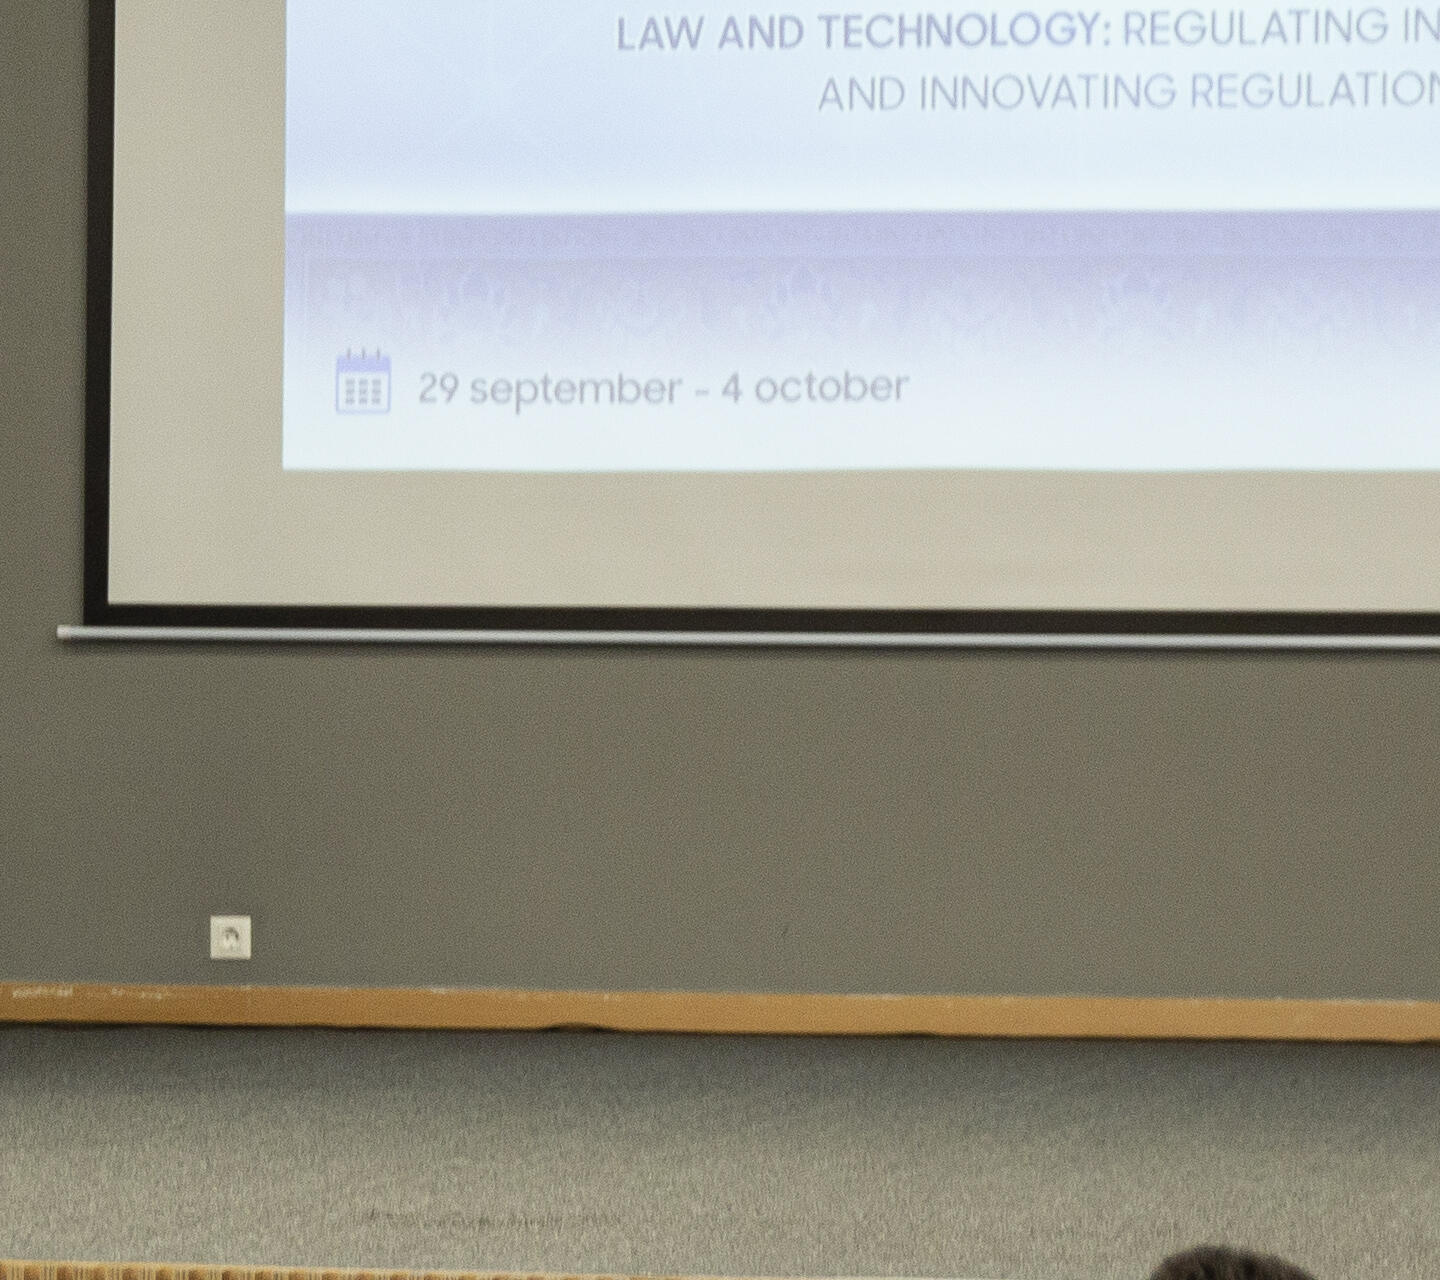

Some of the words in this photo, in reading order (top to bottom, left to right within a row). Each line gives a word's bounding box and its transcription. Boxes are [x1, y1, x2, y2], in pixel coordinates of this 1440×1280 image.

[618, 16, 704, 50] LAW
[718, 15, 804, 49] AND
[818, 11, 1110, 48] TECHNOLOGY:
[1124, 7, 1389, 46] REGULATING
[818, 76, 905, 111] AND
[921, 73, 1176, 110] INNOVATING
[419, 373, 459, 404] 29
[471, 374, 682, 416] september
[722, 373, 742, 403] 4
[754, 371, 909, 404] october
